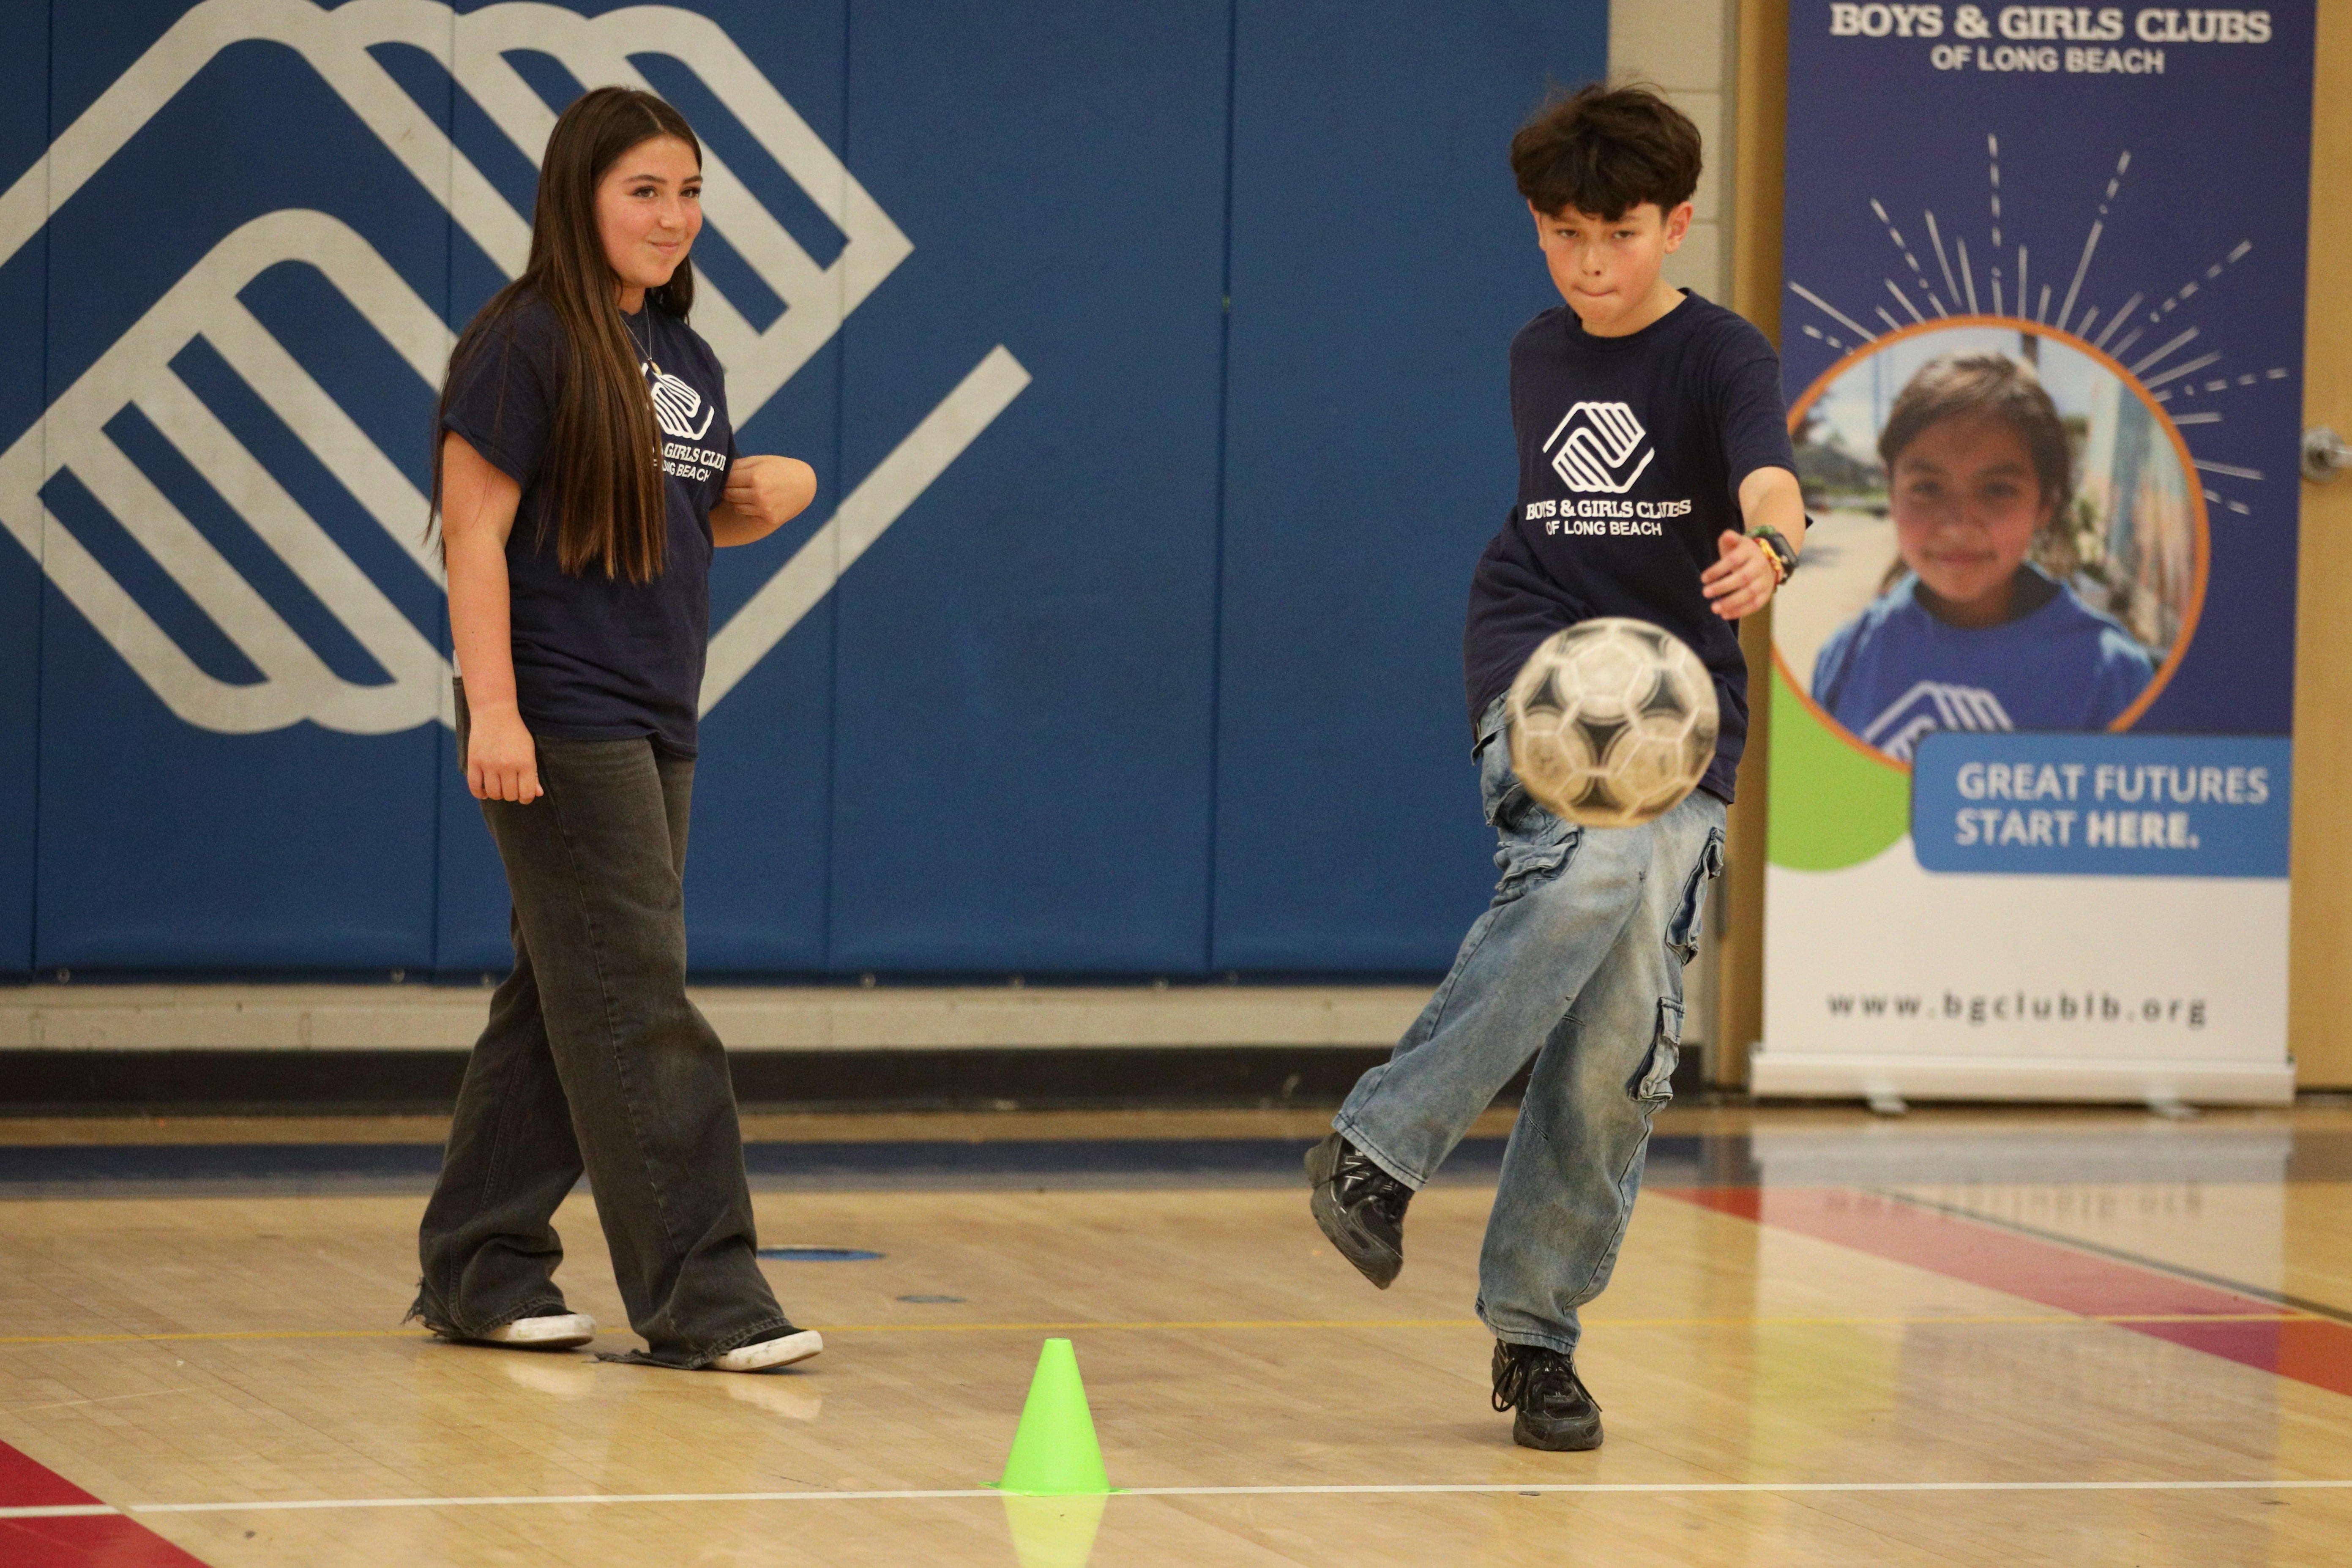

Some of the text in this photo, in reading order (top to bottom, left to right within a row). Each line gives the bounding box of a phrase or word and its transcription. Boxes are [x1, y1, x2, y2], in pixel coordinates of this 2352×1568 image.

[1829, 3, 2272, 43] BOYS & GIRLS CLUBS
[1930, 44, 2166, 74] OF LONG BEACH
[664, 442, 700, 463] GIRLS
[676, 464, 711, 482] BEACH
[1560, 500, 1576, 517] &
[1577, 500, 1634, 518] GIRLS
[1636, 500, 1692, 519] CLUBS
[1546, 520, 1662, 536] OF LONG BEACH
[1956, 762, 2269, 804] GREAT FUTURES
[1954, 808, 2200, 849] START HERE.
[1827, 989, 2207, 1027] www.bgclublb.org
